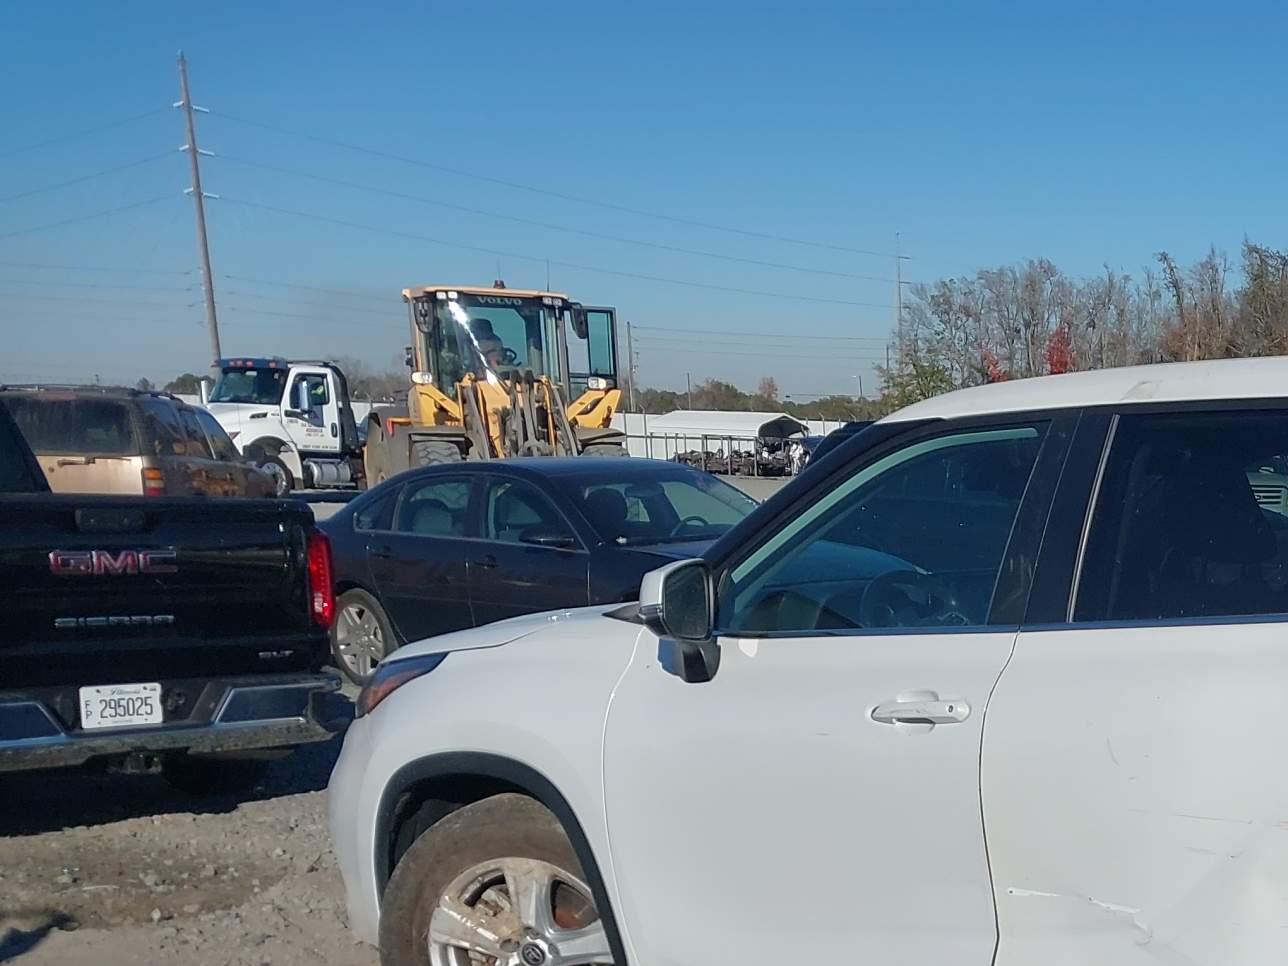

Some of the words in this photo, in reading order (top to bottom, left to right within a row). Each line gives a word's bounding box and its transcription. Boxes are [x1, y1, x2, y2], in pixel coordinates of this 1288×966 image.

[476, 295, 523, 306] VOLVO
[49, 549, 178, 575] GMC
[99, 696, 153, 719] 295025
